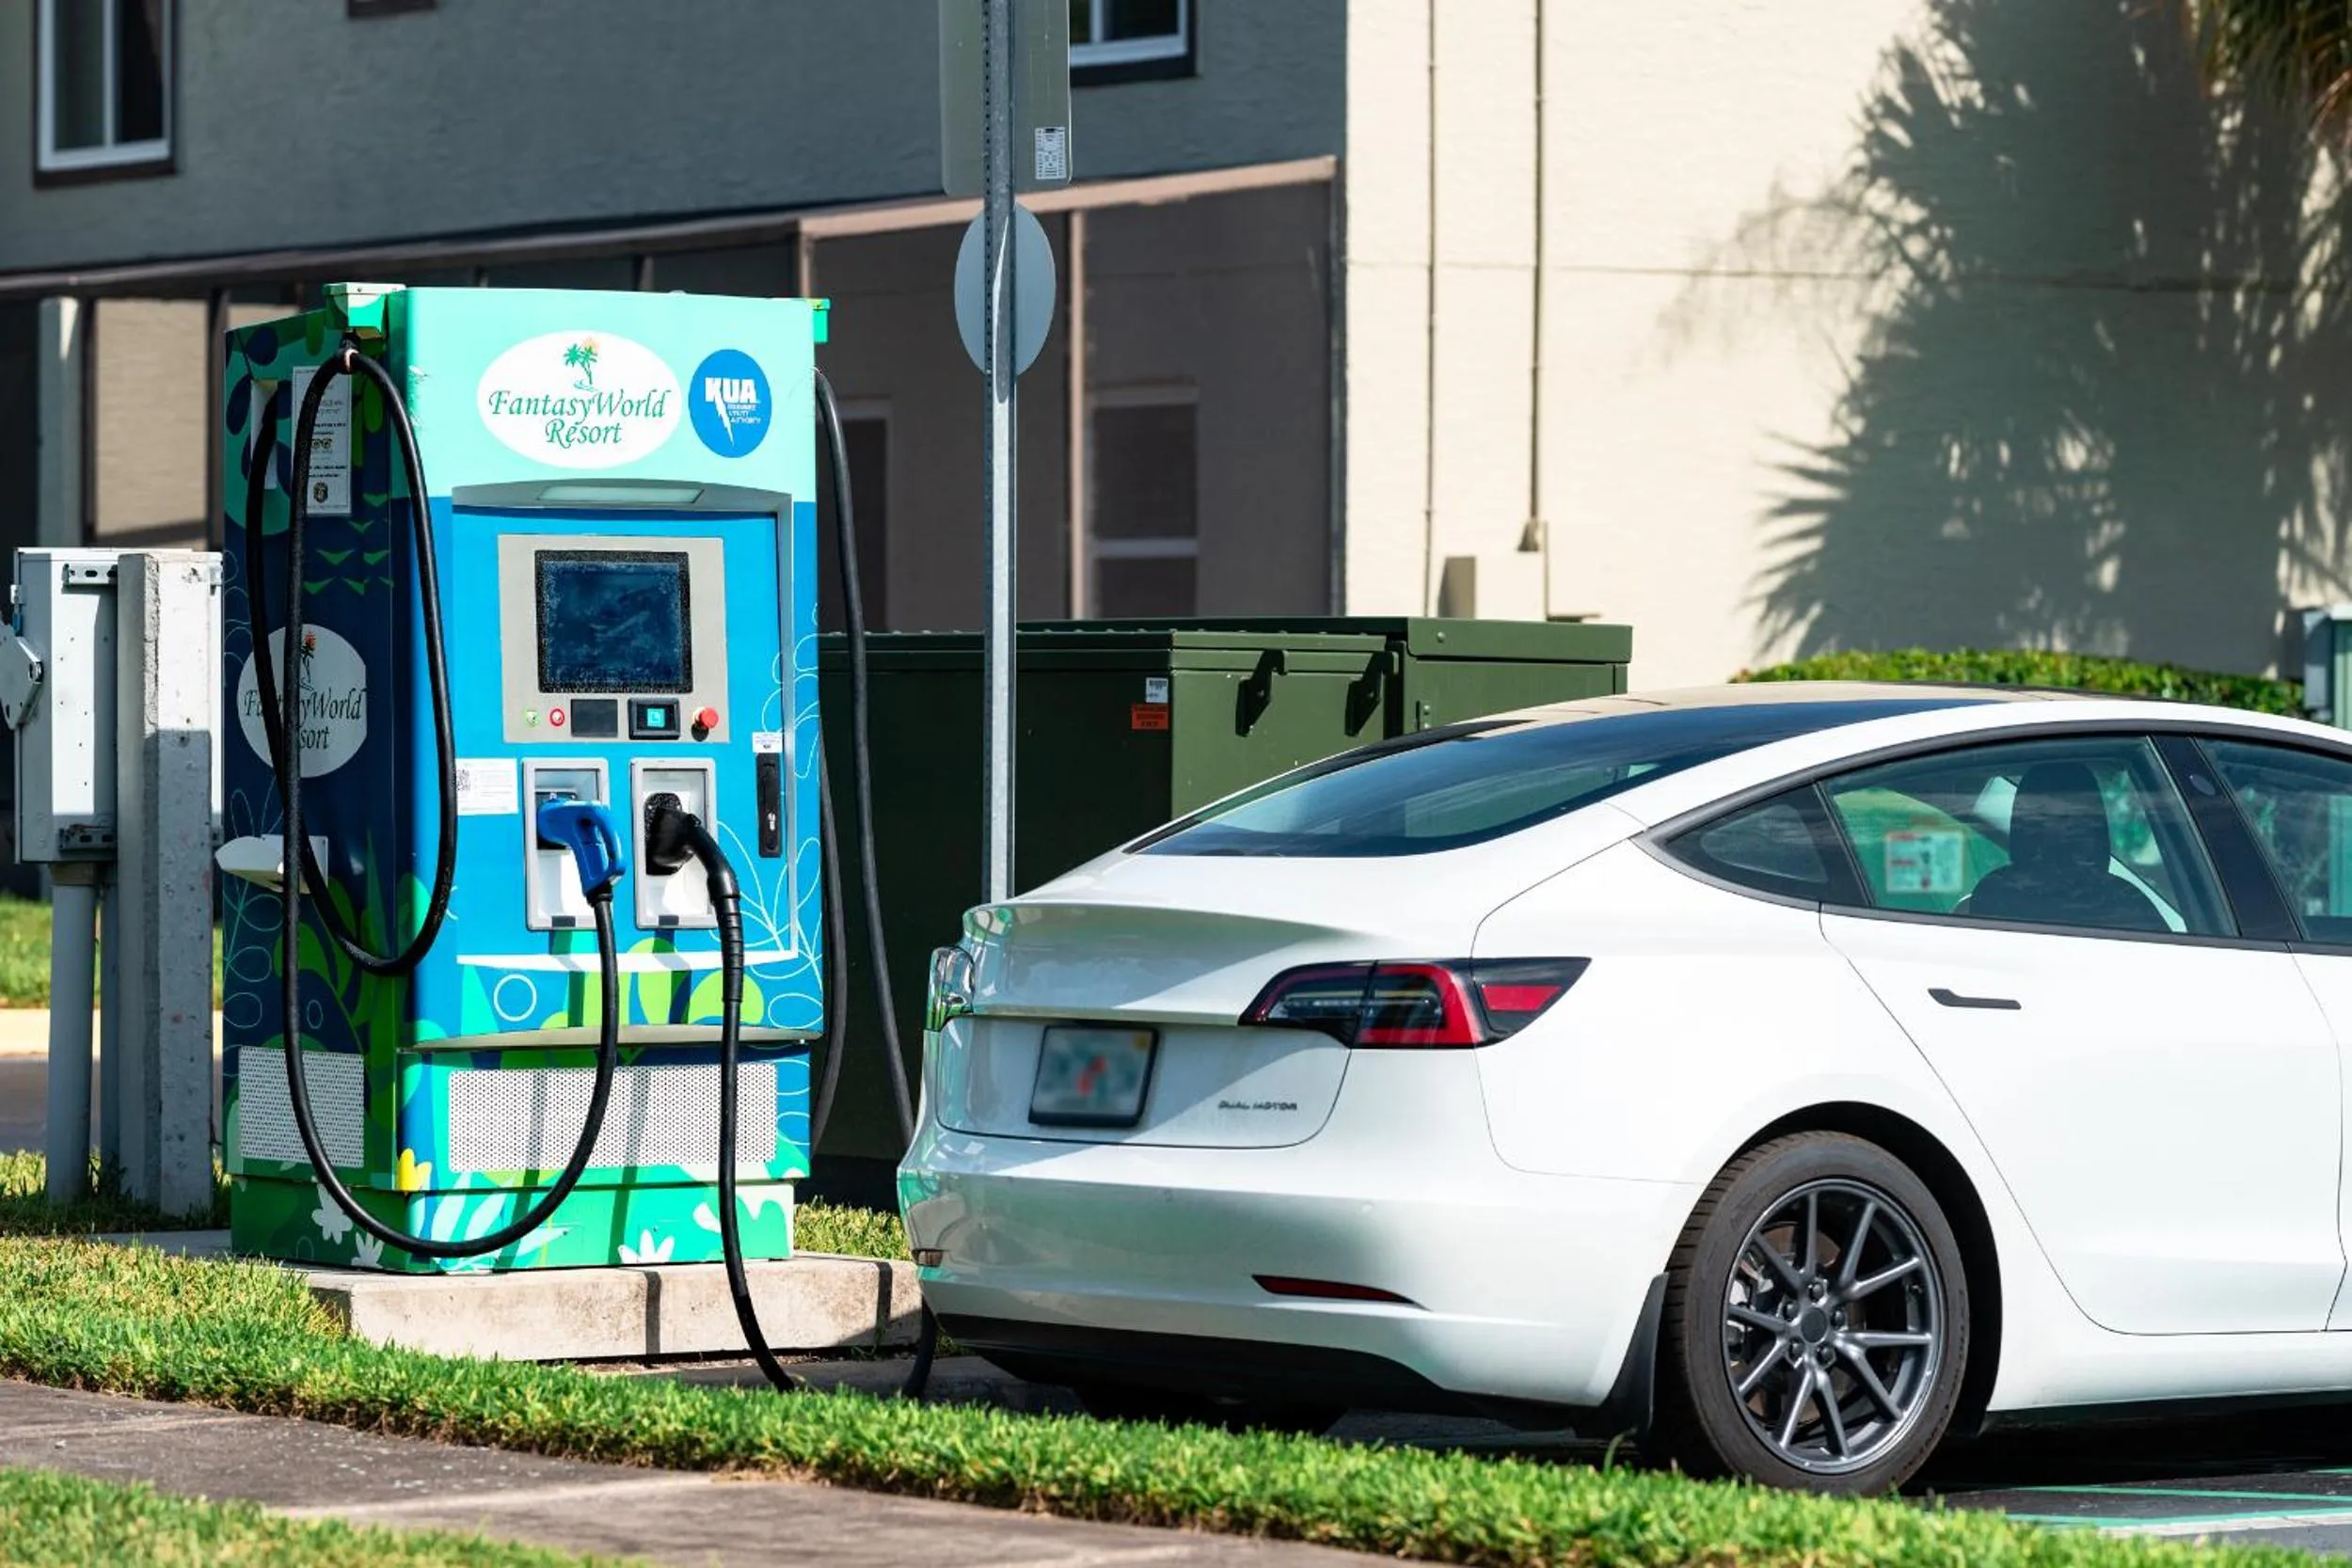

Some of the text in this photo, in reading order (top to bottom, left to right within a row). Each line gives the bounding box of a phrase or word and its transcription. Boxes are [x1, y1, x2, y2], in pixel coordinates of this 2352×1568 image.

[705, 376, 756, 404] KUA
[488, 388, 672, 425] FantasyWorld
[545, 419, 623, 449] Resort
[1252, 1101, 1297, 1111] MOTOR
